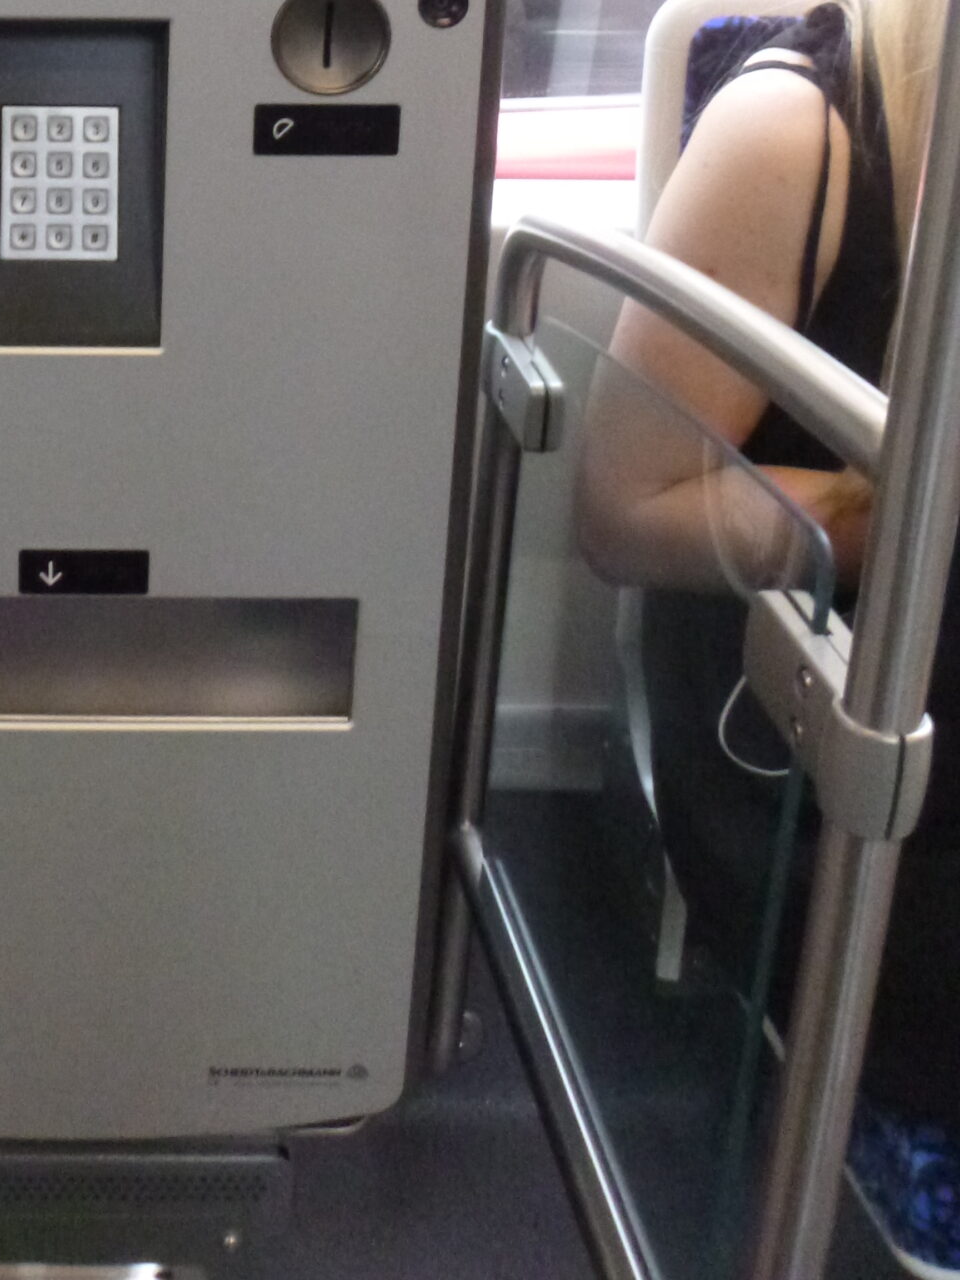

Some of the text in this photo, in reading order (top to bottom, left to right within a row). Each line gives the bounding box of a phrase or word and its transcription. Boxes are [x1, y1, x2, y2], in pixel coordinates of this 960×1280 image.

[21, 122, 29, 135] 1
[55, 123, 64, 136] 2
[20, 159, 28, 170] 4
[19, 195, 27, 207] 7
